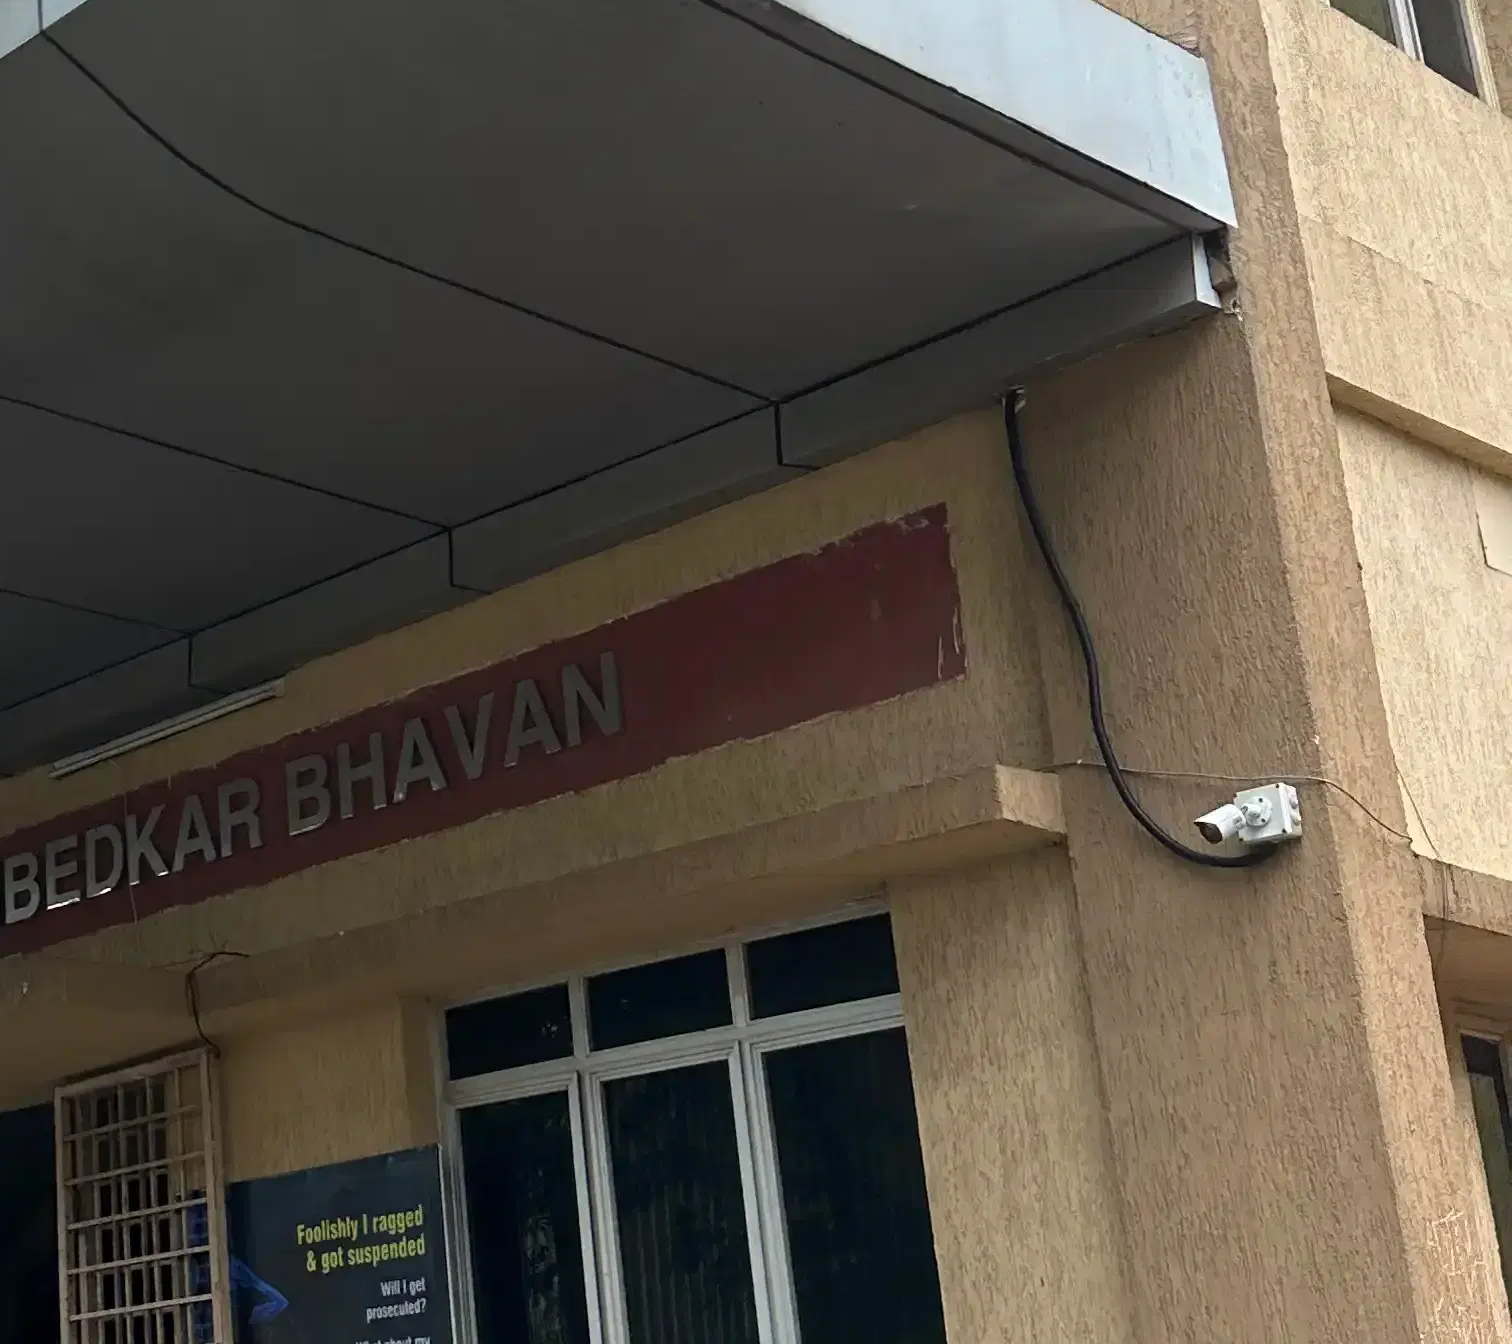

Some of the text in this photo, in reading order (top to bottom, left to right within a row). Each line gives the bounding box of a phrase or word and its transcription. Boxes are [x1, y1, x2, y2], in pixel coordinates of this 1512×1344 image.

[288, 651, 624, 837] BHAVAN
[297, 1203, 424, 1245] Foolishly I ragged
[306, 1233, 426, 1274] & got suspended
[380, 1277, 426, 1297] Will I get
[366, 1297, 427, 1324] prosecuted?
